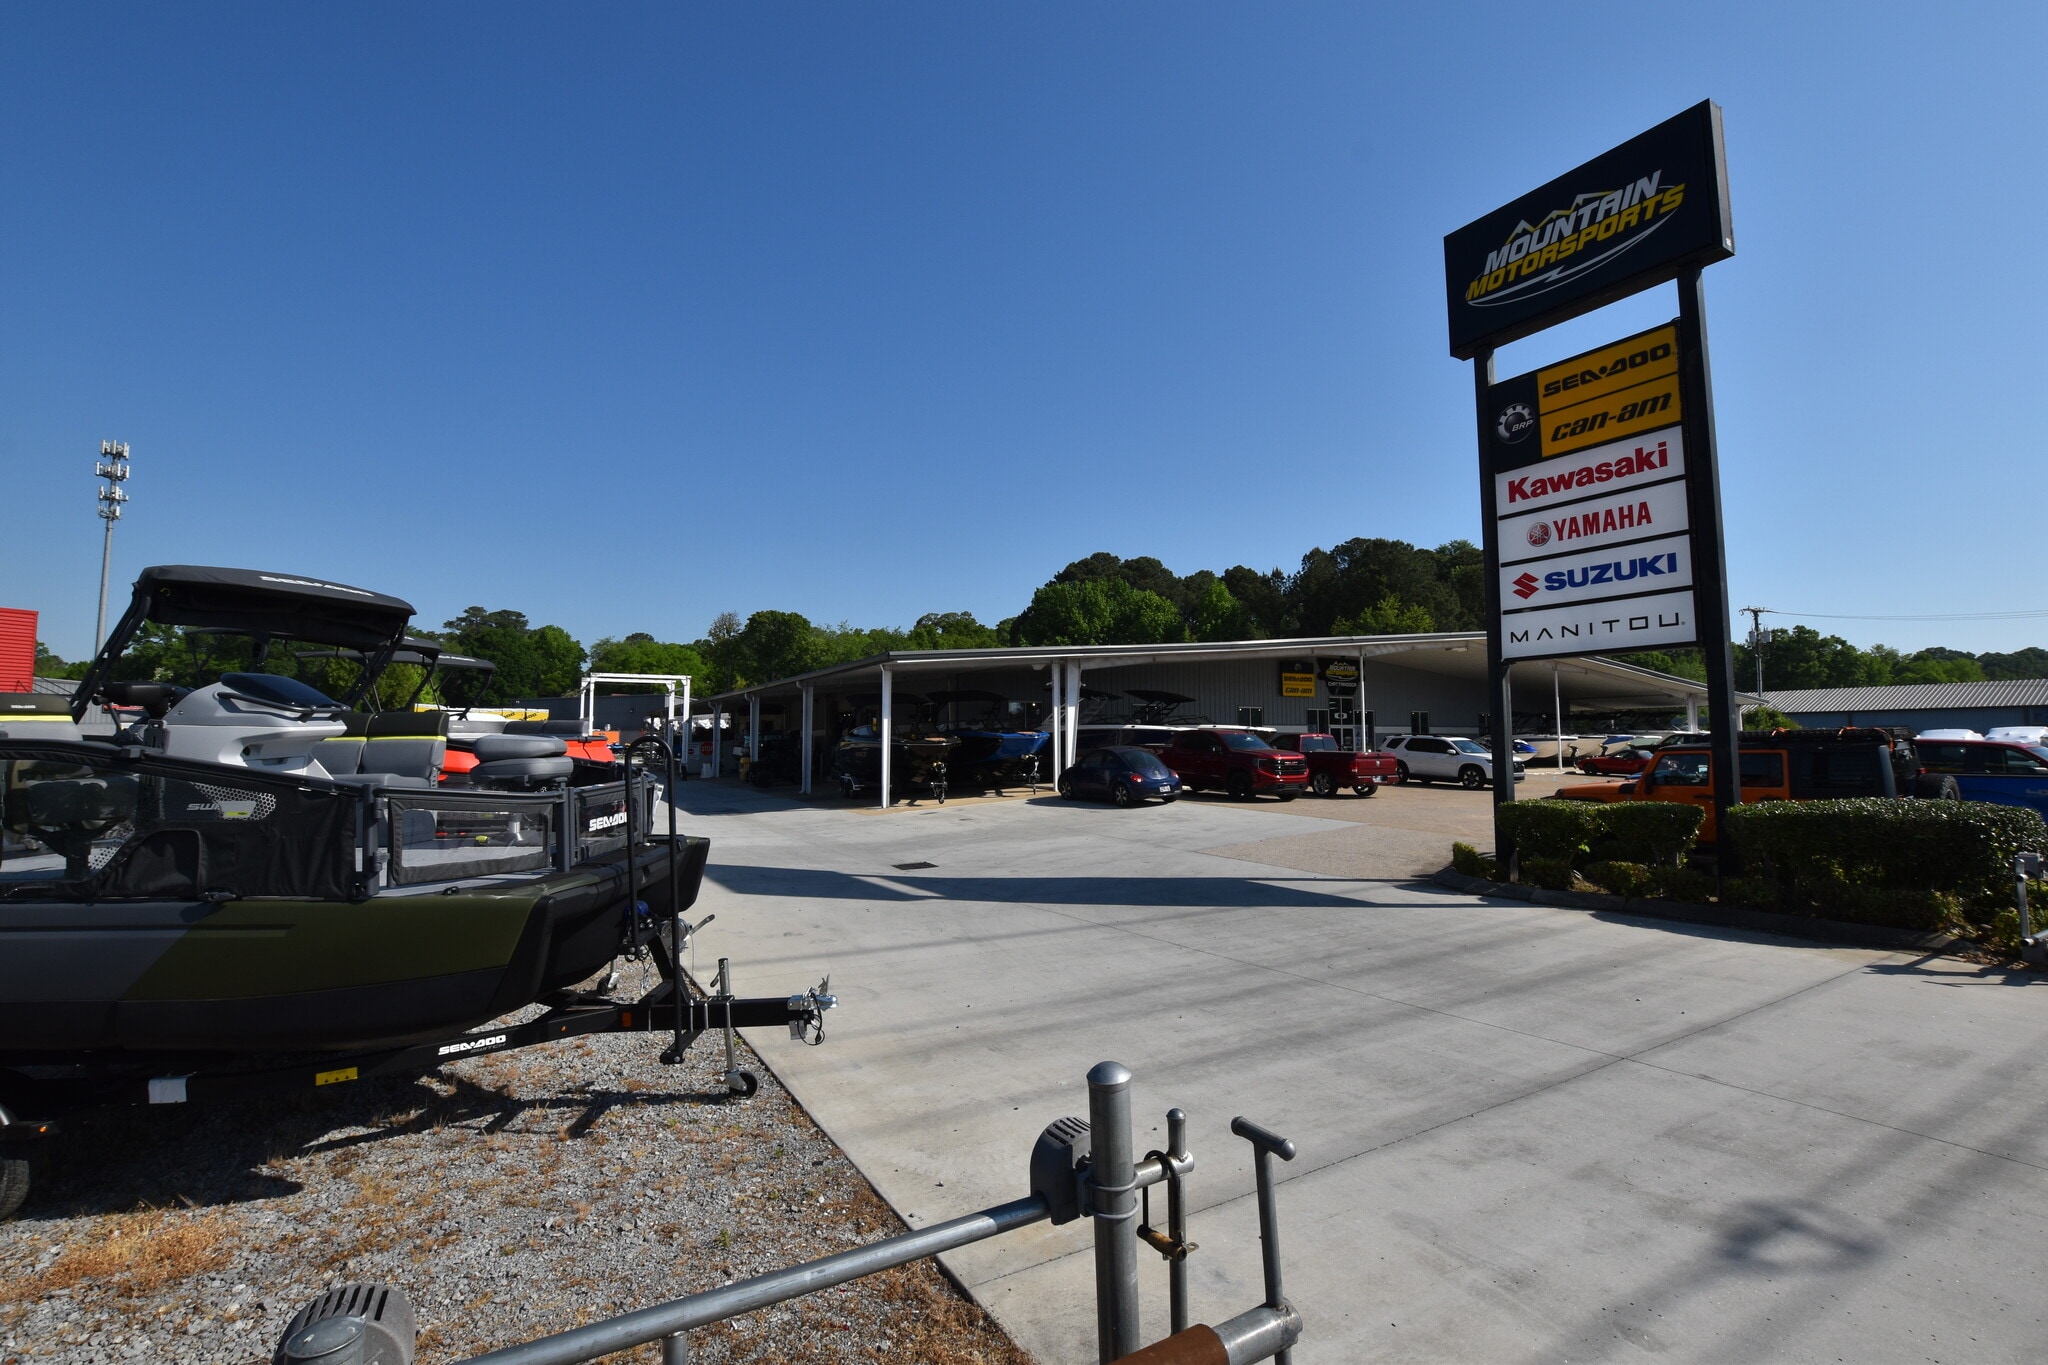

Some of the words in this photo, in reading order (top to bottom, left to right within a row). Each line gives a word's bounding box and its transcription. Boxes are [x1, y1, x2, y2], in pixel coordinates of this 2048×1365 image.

[1465, 183, 1686, 301] MOTORSPORTS
[1483, 169, 1662, 276] MOUNTAIN
[1511, 419, 1534, 432] BRP
[1550, 392, 1672, 443] can-am
[1508, 441, 1668, 503] Kawasaki
[1553, 501, 1652, 541] YAMAHA
[1544, 552, 1678, 592] SUZUKI
[1510, 612, 1680, 643] MANITOU
